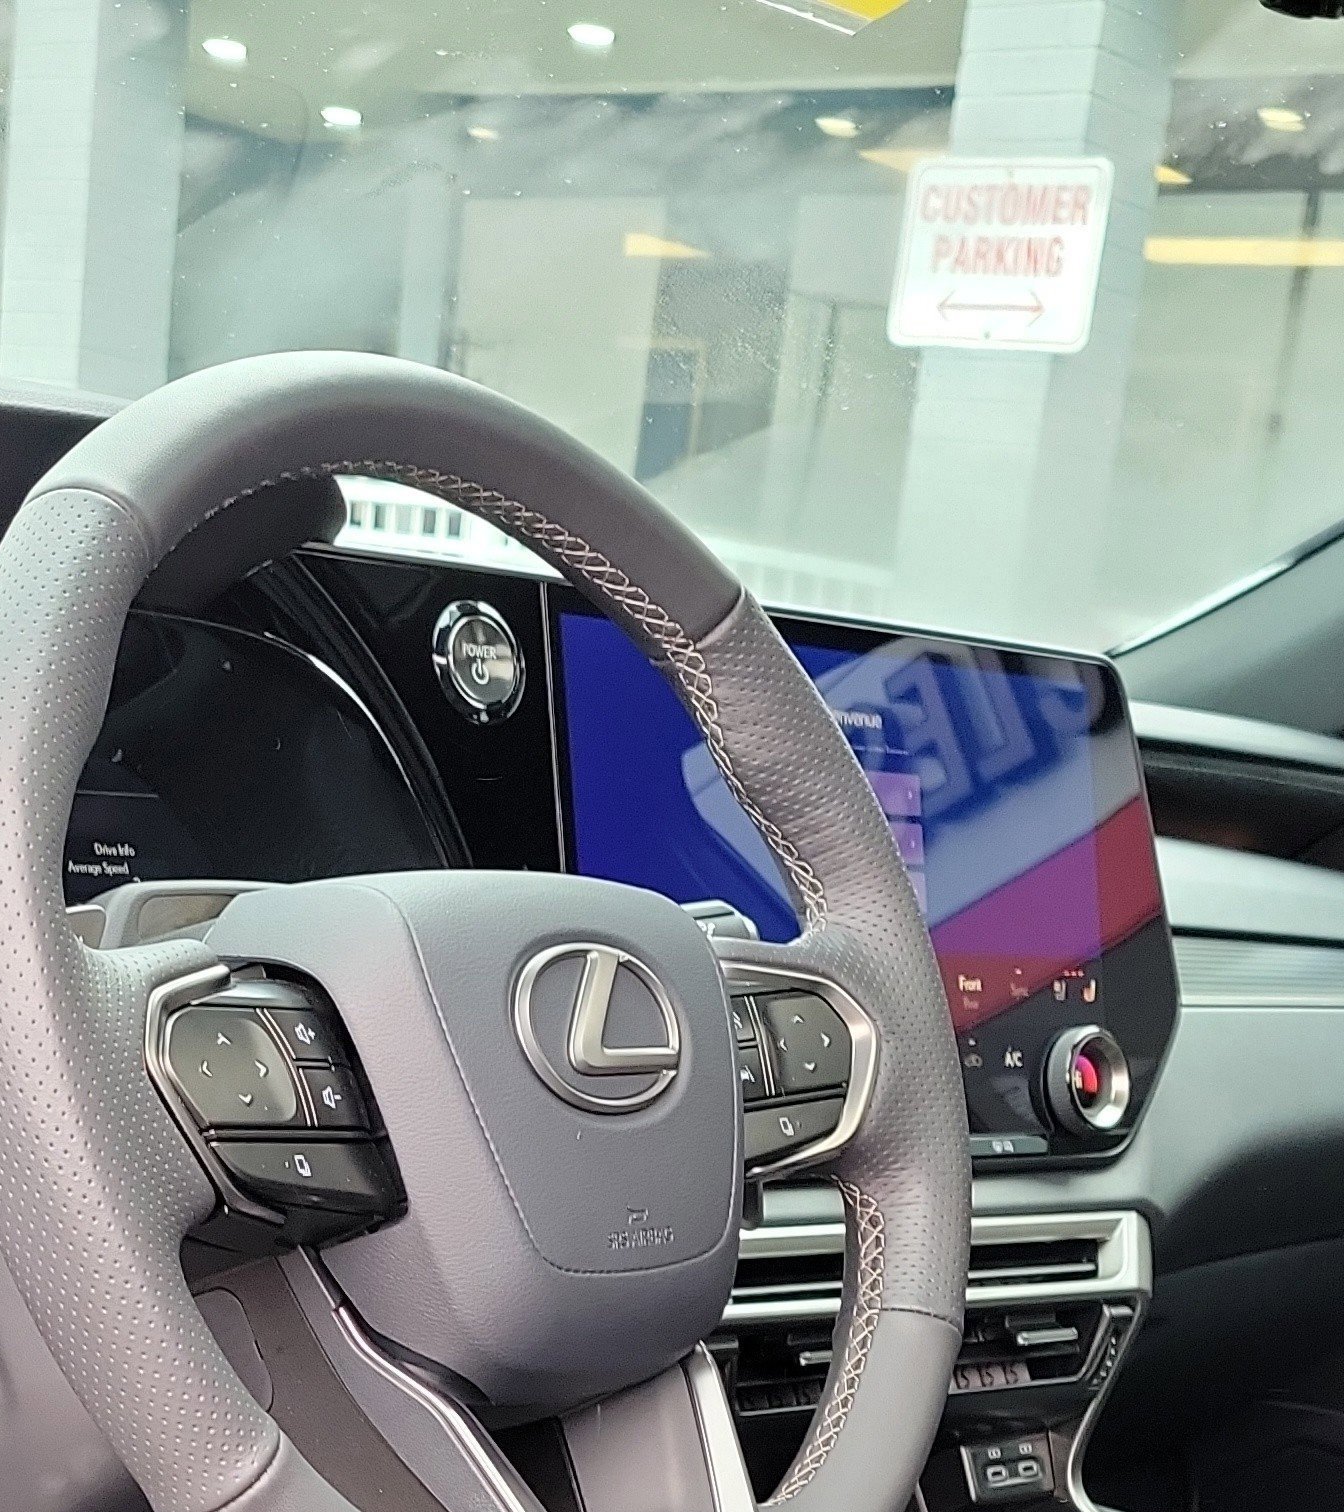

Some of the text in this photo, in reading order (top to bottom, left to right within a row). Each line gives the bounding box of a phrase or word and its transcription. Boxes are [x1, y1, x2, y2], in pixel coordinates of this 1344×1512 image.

[920, 184, 1093, 225] CUSTOMER
[931, 235, 1064, 277] PARKING
[462, 643, 496, 659] POWER
[68, 860, 130, 876] Average Speed
